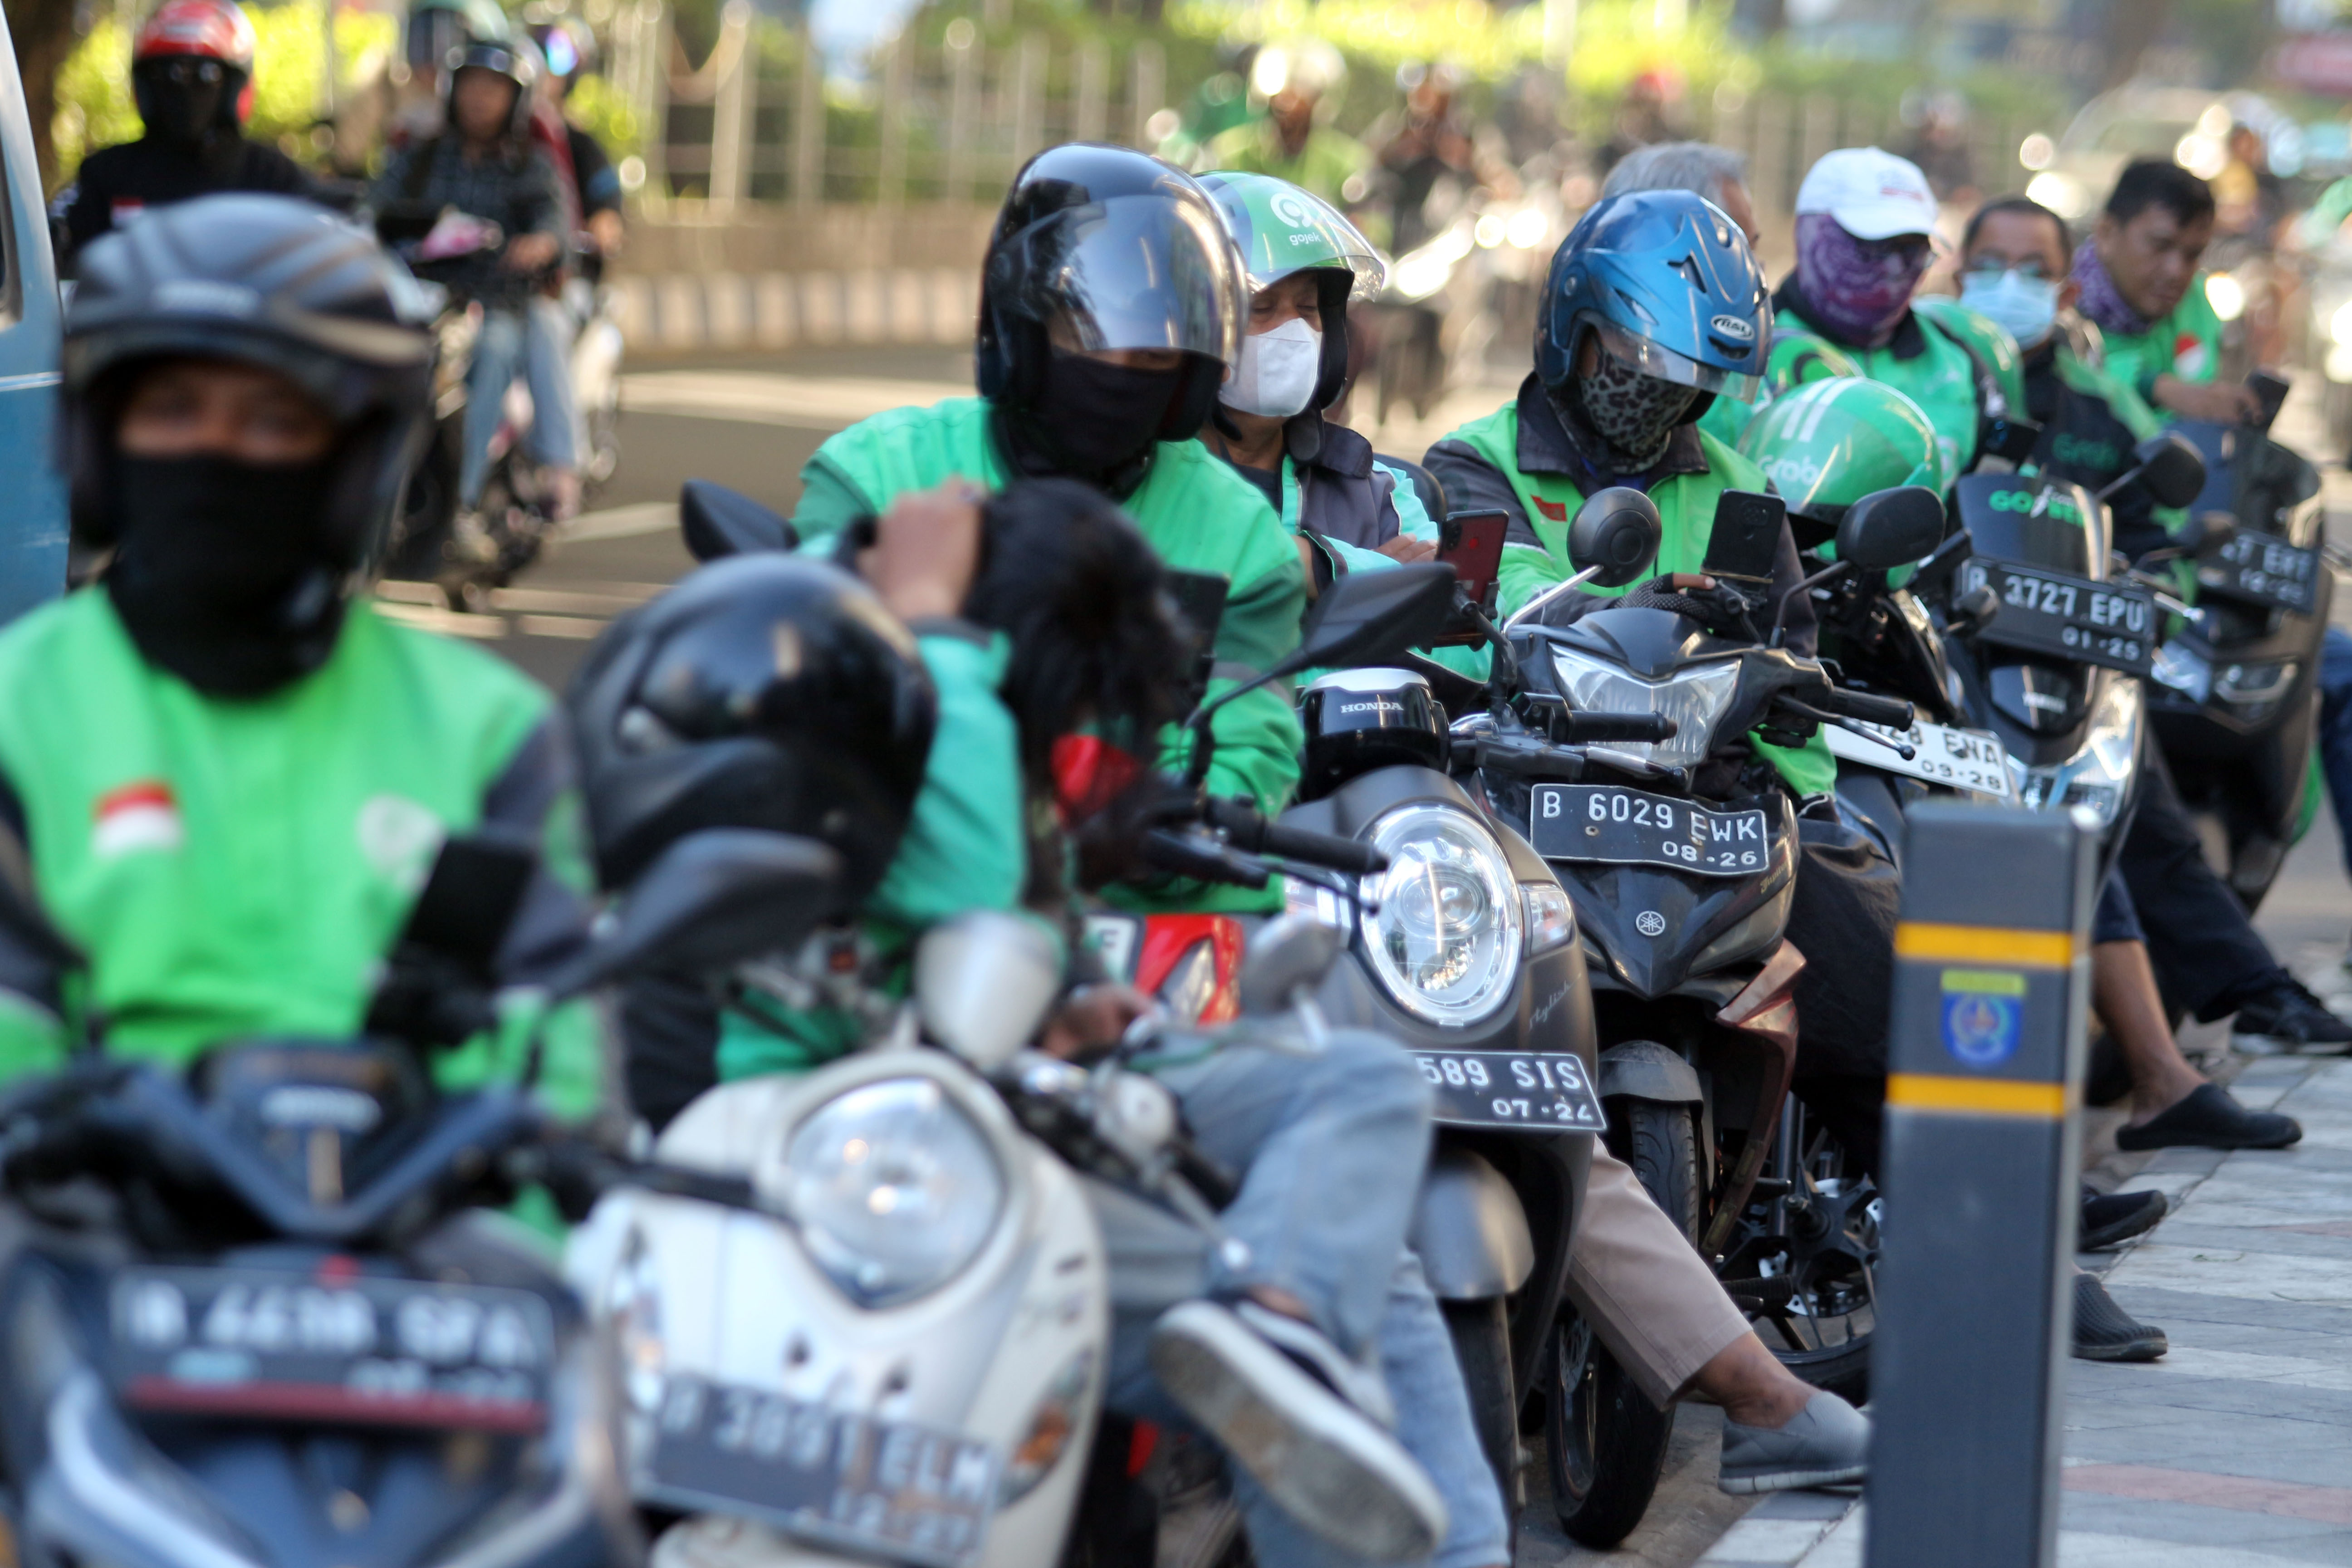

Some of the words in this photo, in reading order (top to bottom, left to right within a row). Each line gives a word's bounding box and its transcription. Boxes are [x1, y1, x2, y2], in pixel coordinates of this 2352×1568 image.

[1289, 231, 1321, 246] gojek
[1757, 455, 1820, 486] Grab
[2090, 593, 2144, 632] EPU
[1340, 702, 1404, 713] HONDA
[1543, 791, 1561, 818] B
[1588, 793, 1673, 829] 6029
[1690, 811, 1758, 842] EWK
[1510, 1060, 1581, 1089] SIS
